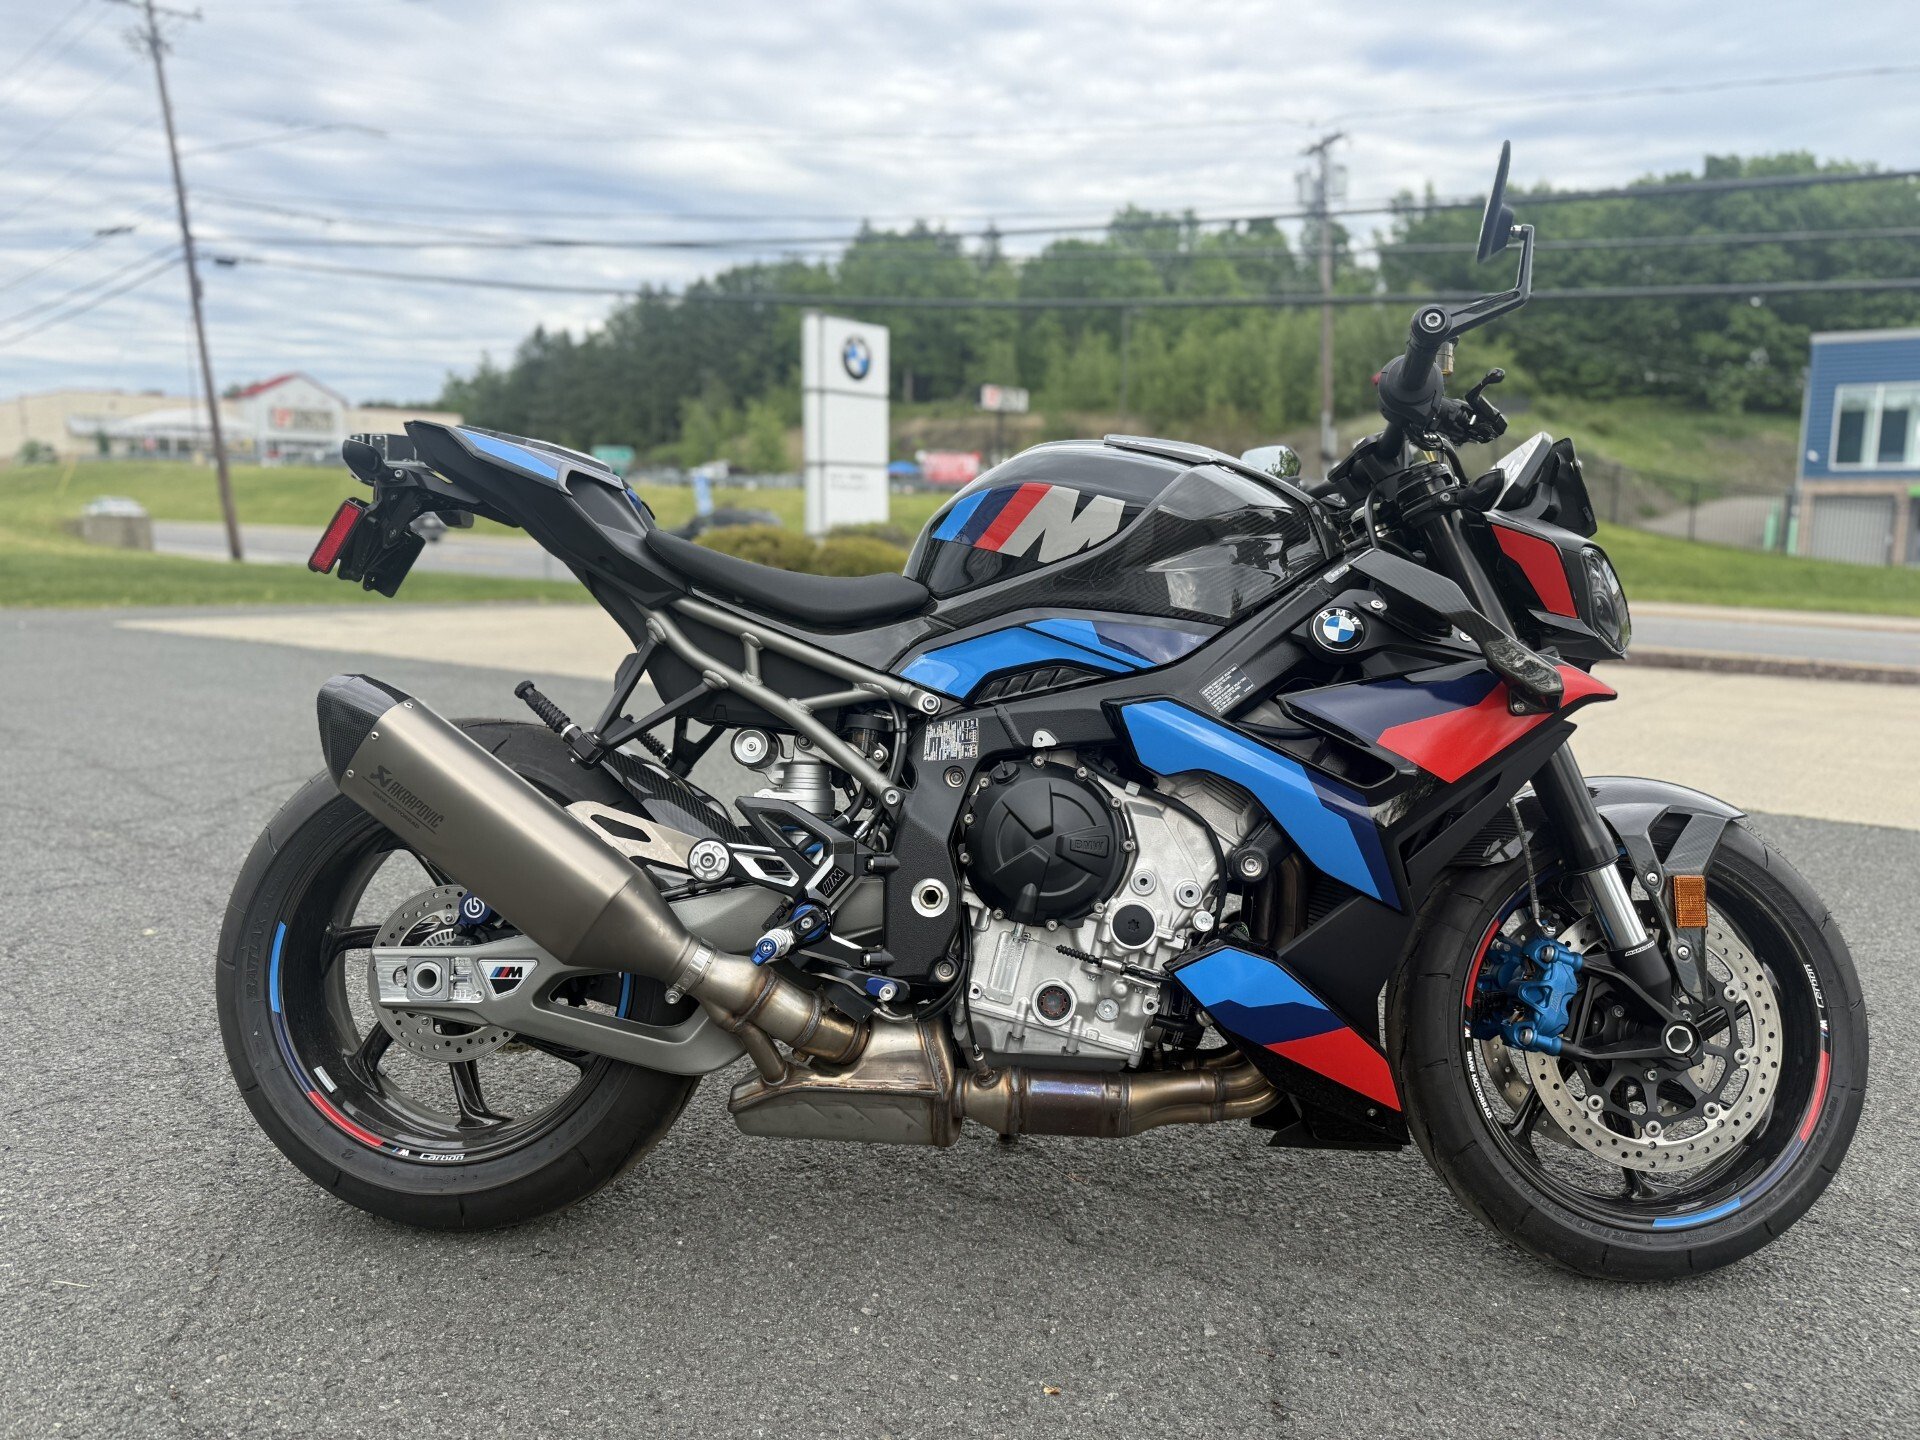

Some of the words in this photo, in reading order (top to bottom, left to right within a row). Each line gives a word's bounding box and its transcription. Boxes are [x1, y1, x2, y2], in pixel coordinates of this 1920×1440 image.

[997, 485, 1126, 563] M
[1319, 609, 1361, 625] BMW
[1074, 839, 1104, 850] BMW
[1466, 1051, 1475, 1072] BMW
[1471, 1073, 1492, 1119] MOTORRAD
[419, 1152, 466, 1161] Carbon
